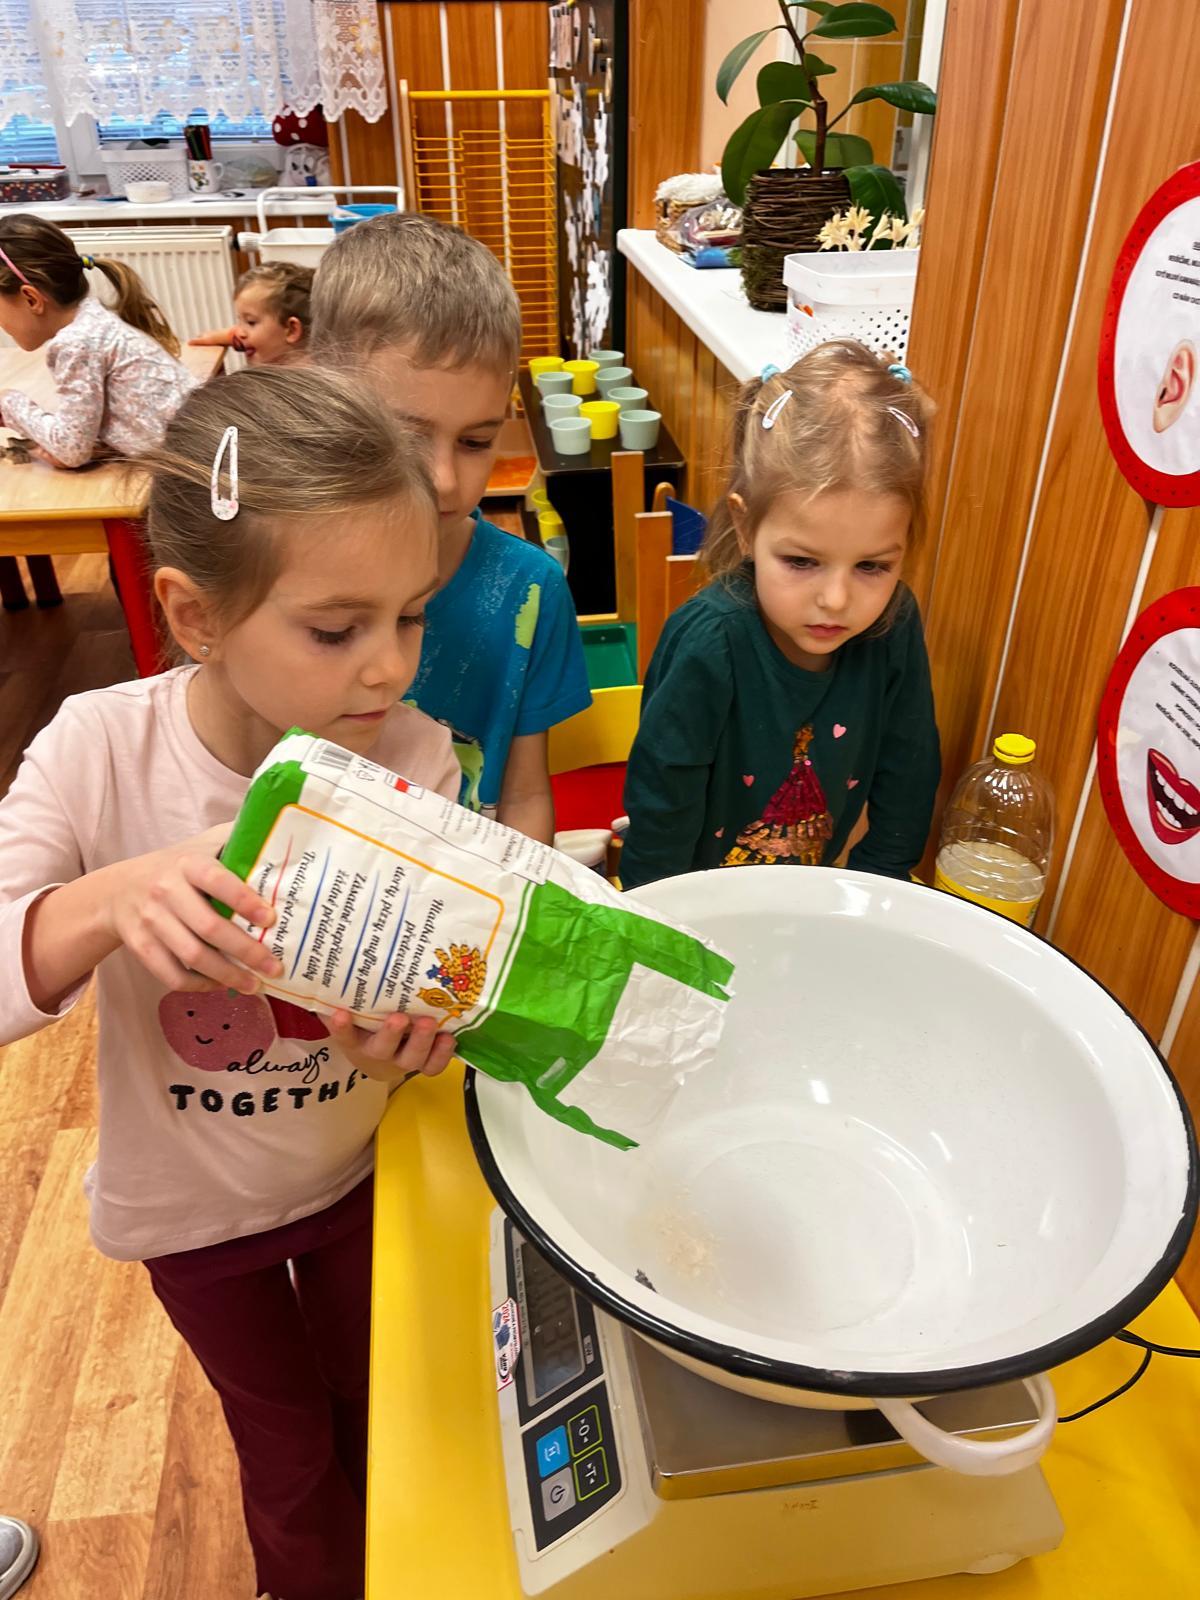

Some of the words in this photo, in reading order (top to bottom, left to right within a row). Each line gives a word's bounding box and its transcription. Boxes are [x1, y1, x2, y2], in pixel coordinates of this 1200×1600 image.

[288, 851, 315, 902] Tradičně
[328, 869, 349, 907] žádné
[384, 866, 406, 898] dorty,
[283, 900, 297, 917] od
[341, 873, 367, 923] Zásadně
[372, 899, 393, 932] pizzy,
[275, 915, 289, 942] roku
[312, 904, 334, 957] přídatné
[419, 899, 444, 943] Hladká
[302, 955, 321, 981] látky
[357, 935, 380, 976] muffiny,
[389, 920, 416, 979] především
[406, 944, 425, 984] mouka
[401, 981, 415, 994] je
[226, 1046, 329, 1084] always
[169, 1070, 368, 1117] TOGETHE
